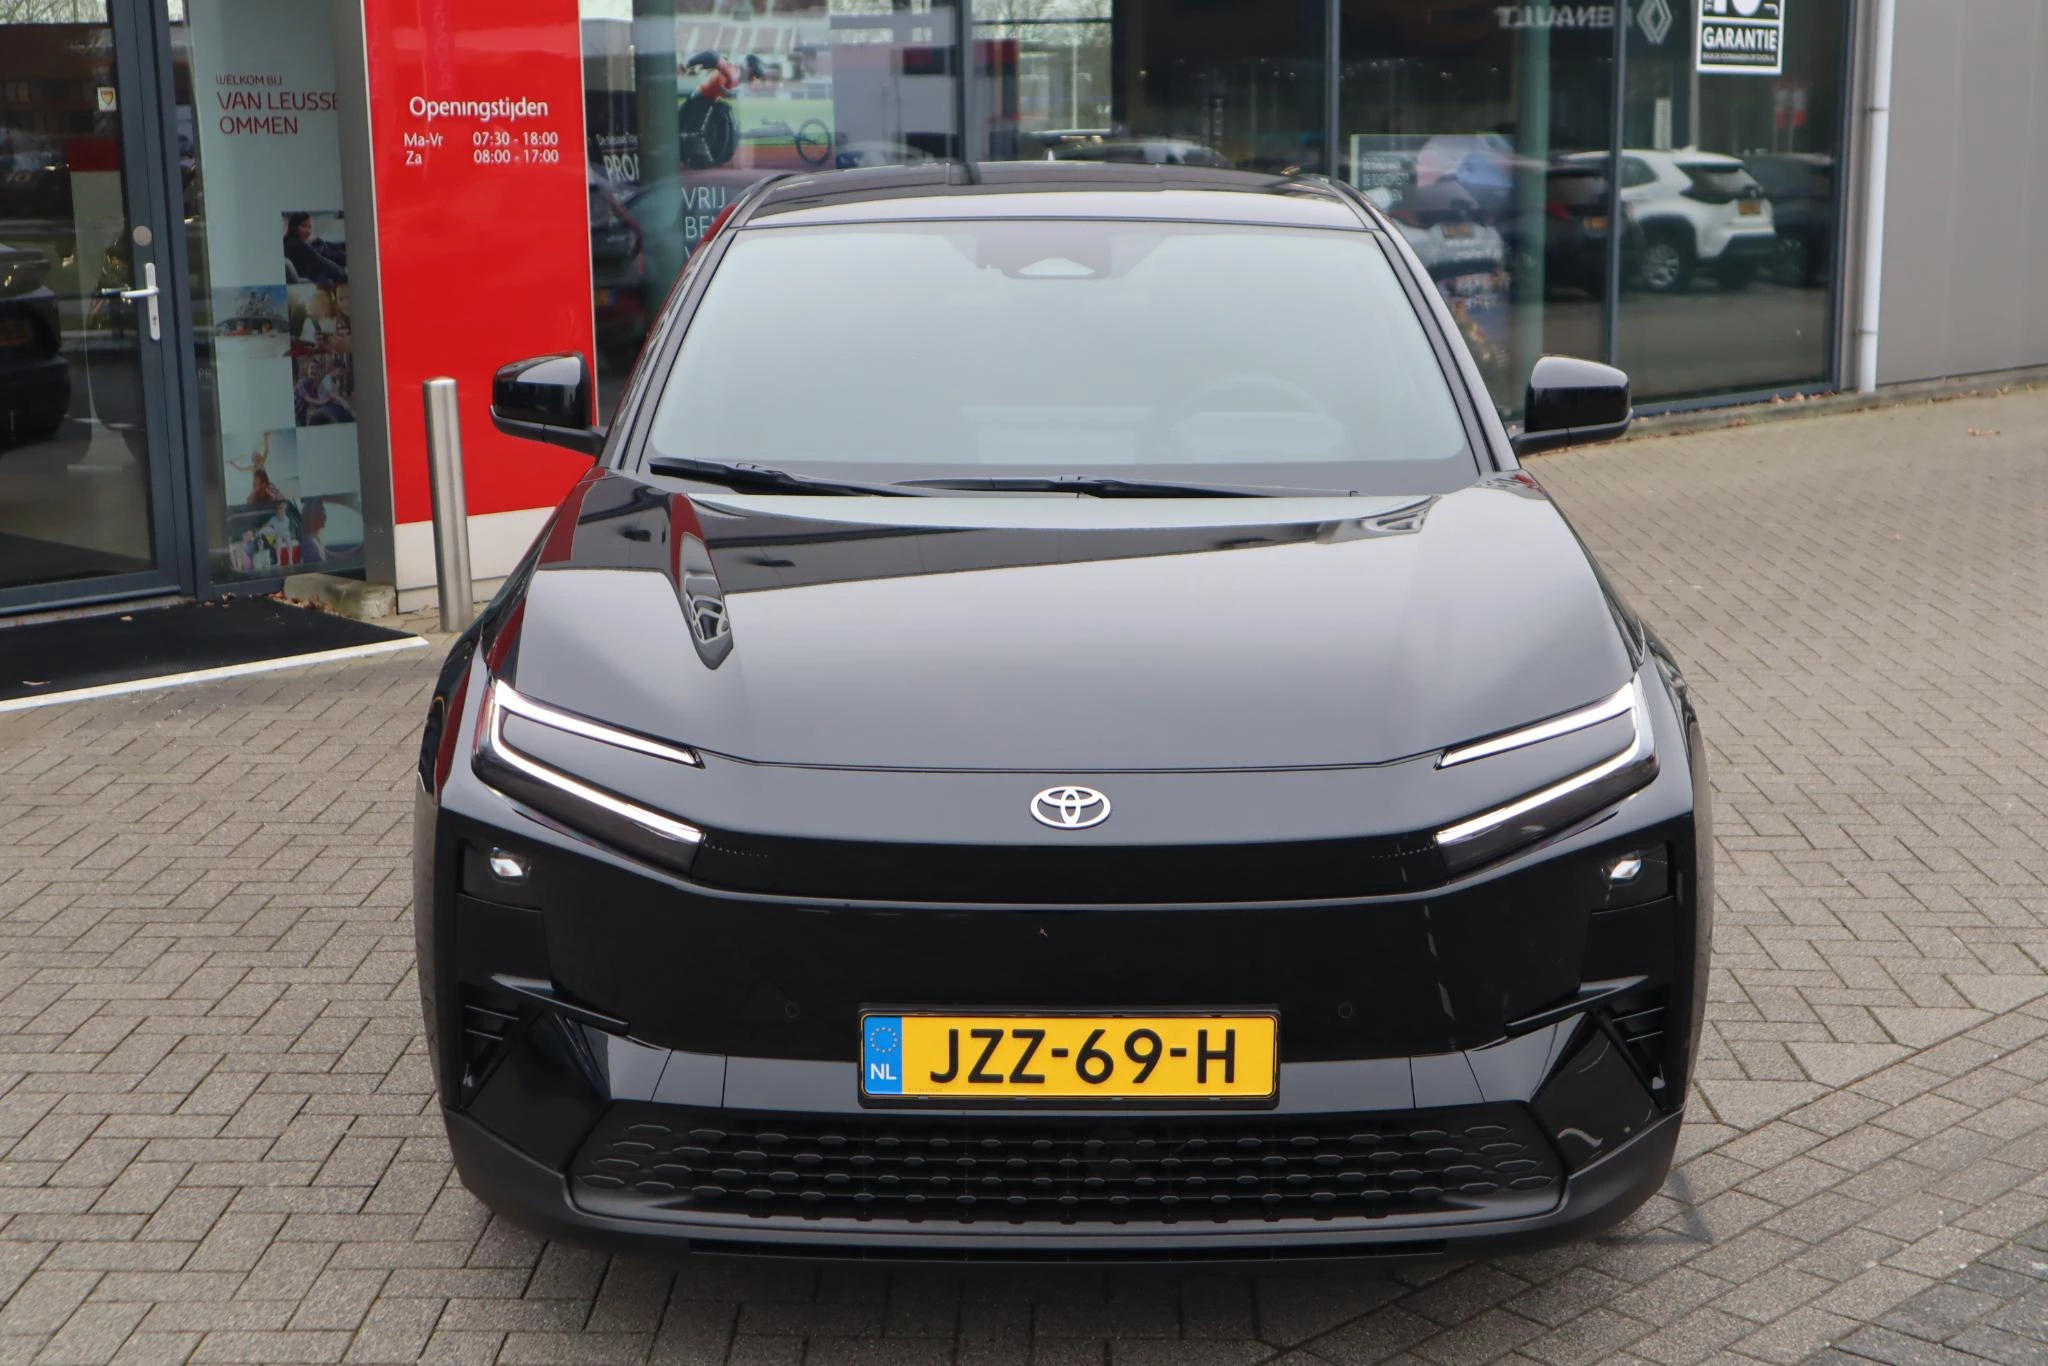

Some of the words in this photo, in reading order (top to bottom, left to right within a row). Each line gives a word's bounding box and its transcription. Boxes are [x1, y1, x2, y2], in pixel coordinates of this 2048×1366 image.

[1703, 26, 1778, 50] GARANTIE
[216, 73, 264, 86] WELKOM
[266, 75, 282, 86] BIJ
[217, 91, 262, 110] VAN
[409, 96, 549, 122] Openingstijden
[219, 115, 298, 135] OMMEN
[403, 132, 444, 147] Ma-Vr
[472, 131, 511, 146] 07:30
[523, 131, 559, 146] 18:00
[405, 151, 423, 165] Za
[473, 150, 511, 164] 08:00
[523, 150, 560, 164] 17:00
[681, 187, 725, 209] VRIJ
[930, 1028, 1236, 1084] JZZ-69-H
[870, 1063, 897, 1081] NL
